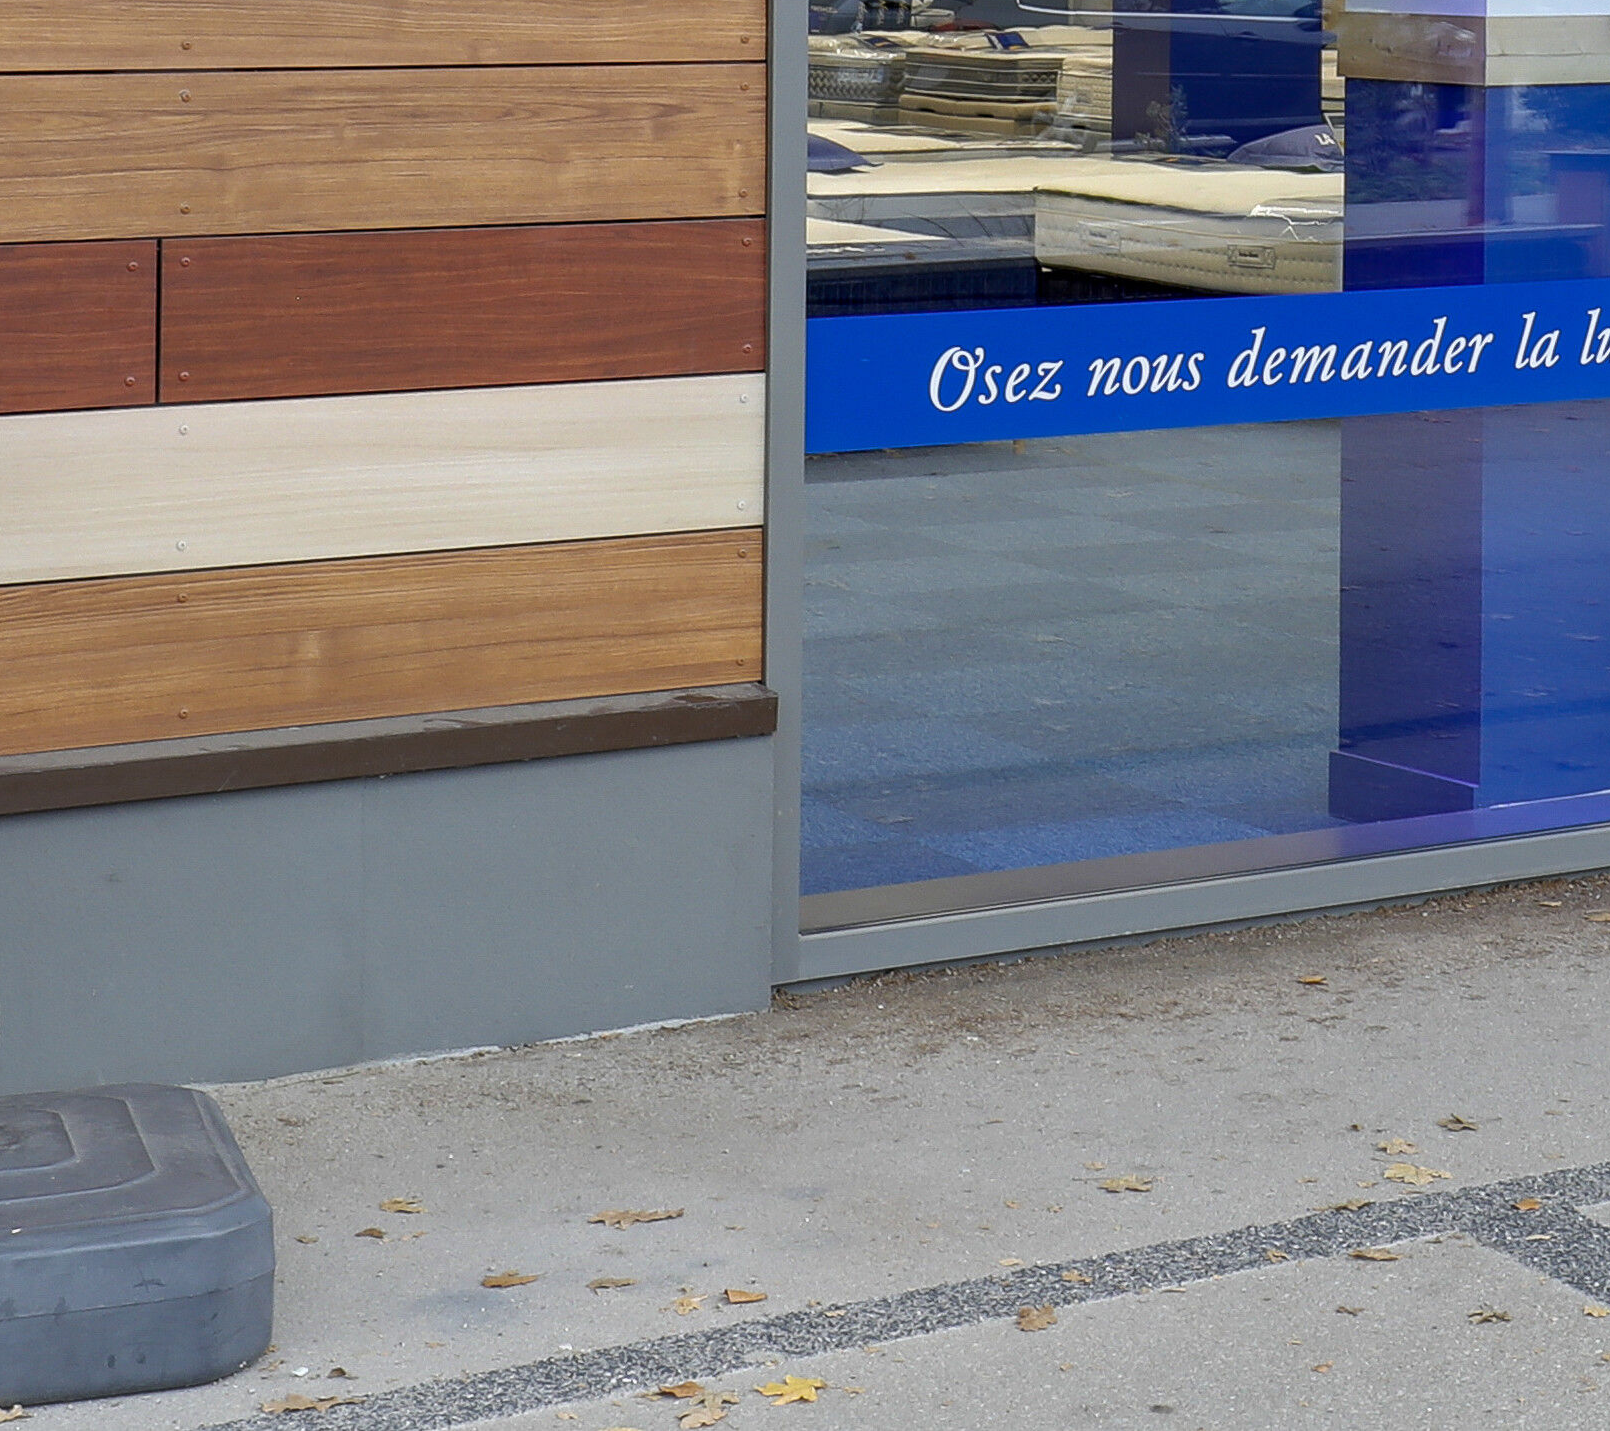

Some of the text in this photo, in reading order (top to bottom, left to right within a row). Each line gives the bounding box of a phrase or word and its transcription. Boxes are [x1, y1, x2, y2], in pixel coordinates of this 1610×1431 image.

[928, 345, 1062, 413] Osez
[1087, 341, 1204, 399] nous
[1226, 316, 1495, 388] demander
[1515, 311, 1560, 370] la
